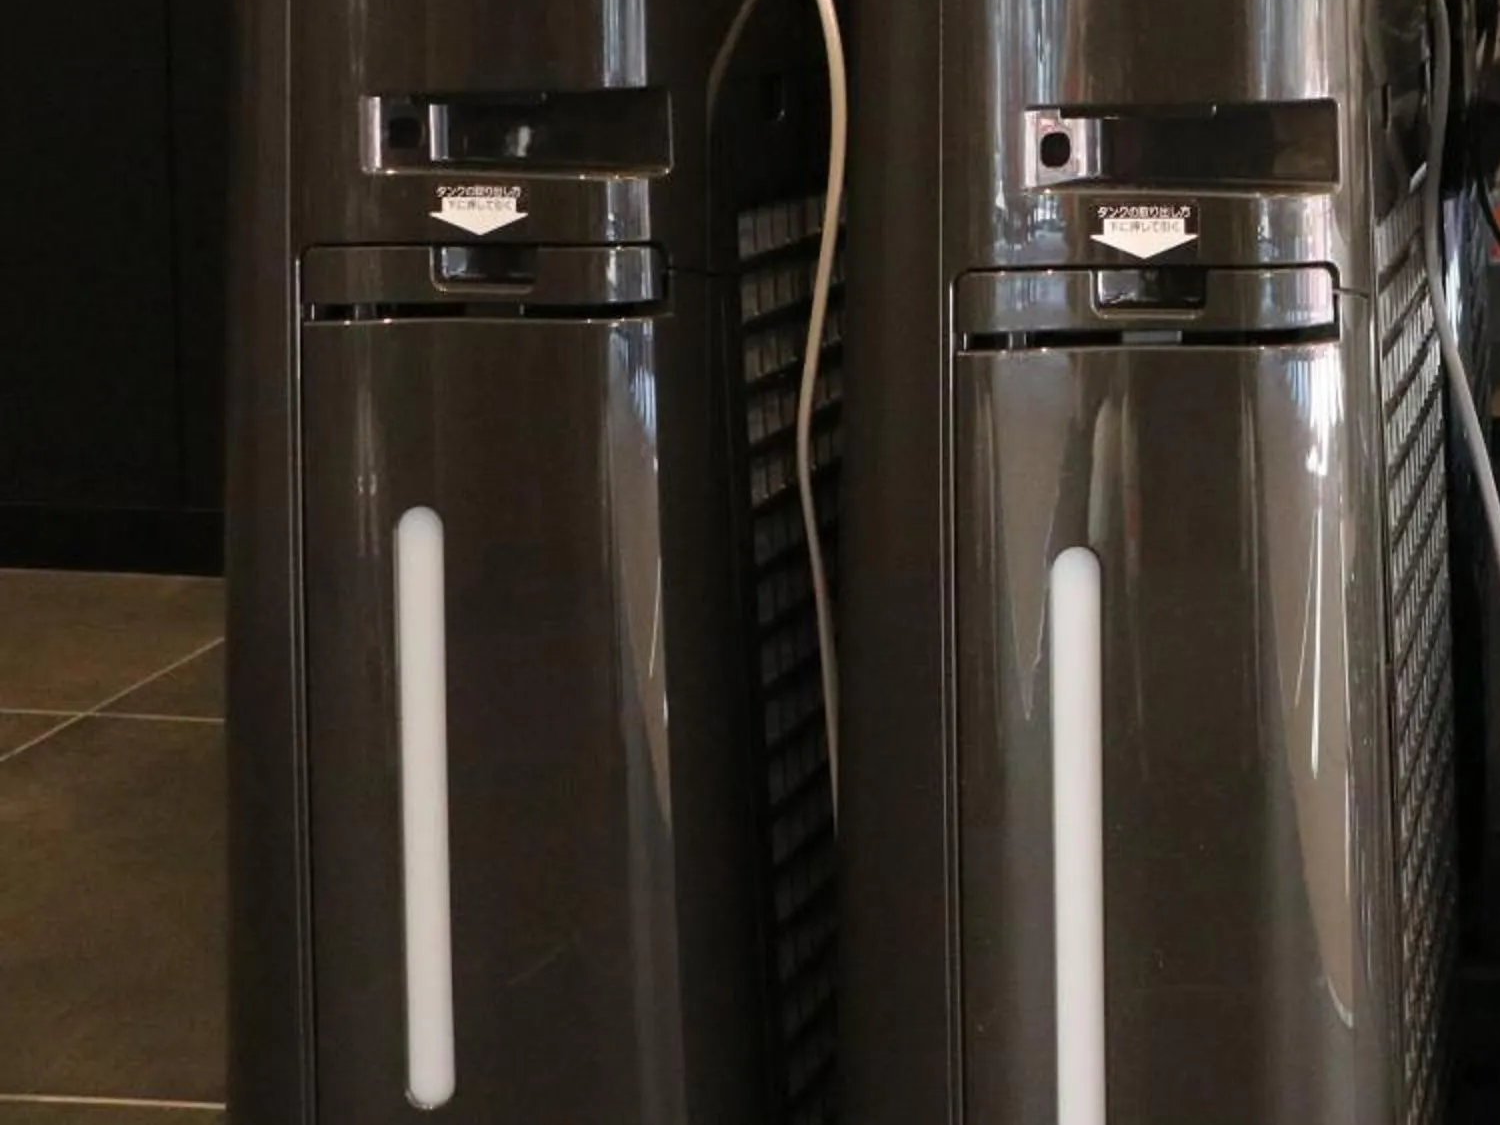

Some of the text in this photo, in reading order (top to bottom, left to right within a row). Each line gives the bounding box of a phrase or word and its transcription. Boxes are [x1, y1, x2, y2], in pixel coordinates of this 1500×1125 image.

[1097, 205, 1192, 219] タンクの取り出し方
